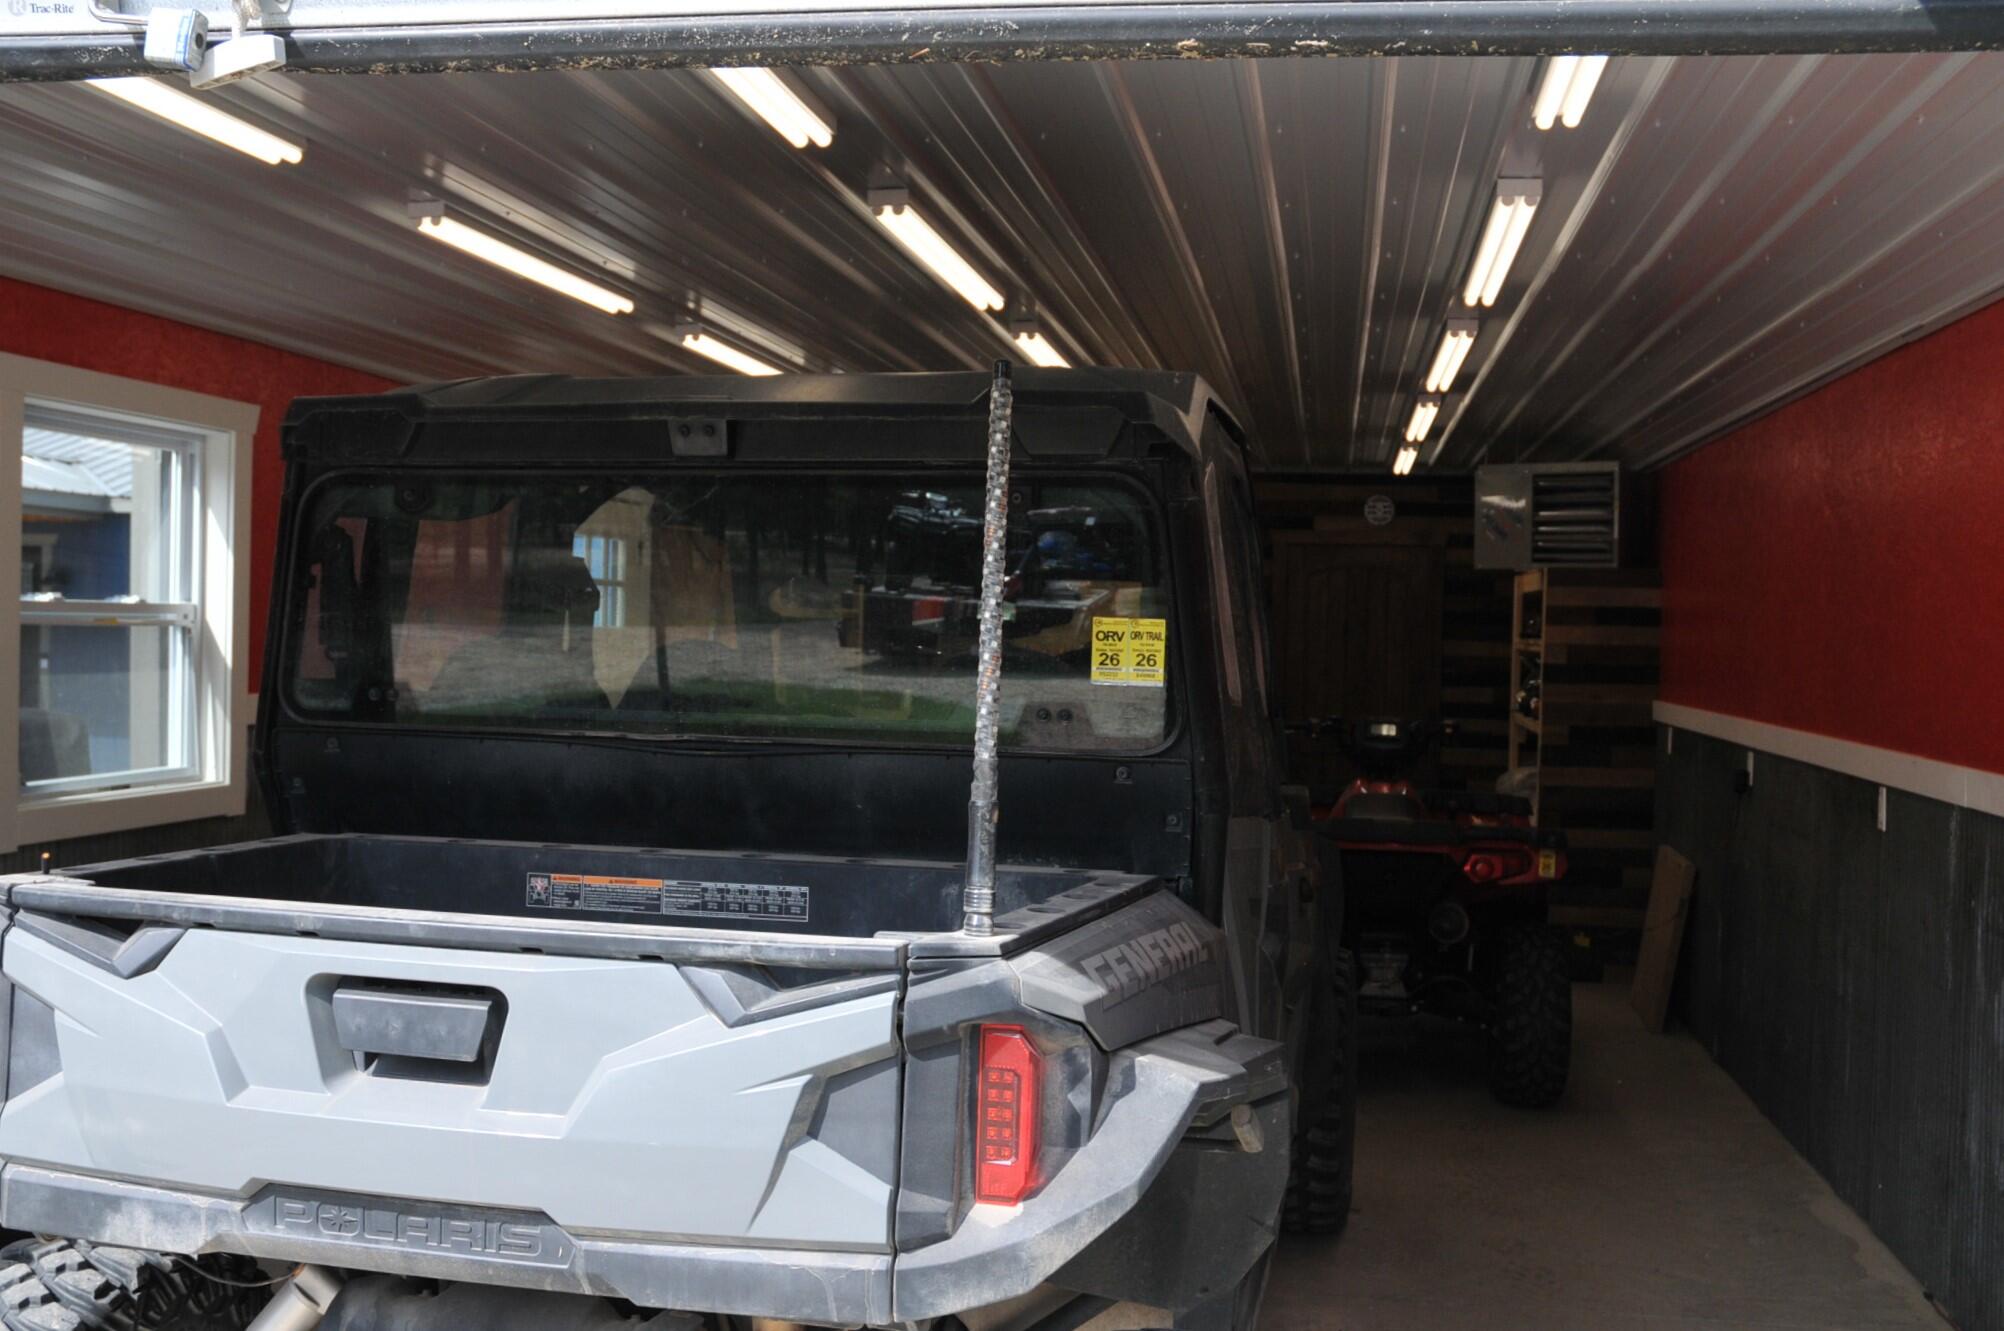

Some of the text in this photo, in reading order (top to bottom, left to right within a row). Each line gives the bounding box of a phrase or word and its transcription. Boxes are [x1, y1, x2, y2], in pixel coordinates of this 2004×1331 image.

[29, 3, 75, 14] Trac-Rite
[1095, 630, 1125, 642] ORV
[1130, 630, 1164, 642] ORV TRAIL
[1098, 652, 1120, 667] 26
[1135, 653, 1157, 667] 26
[1081, 921, 1208, 1010] GENERAL
[274, 1196, 542, 1257] POLARIS
